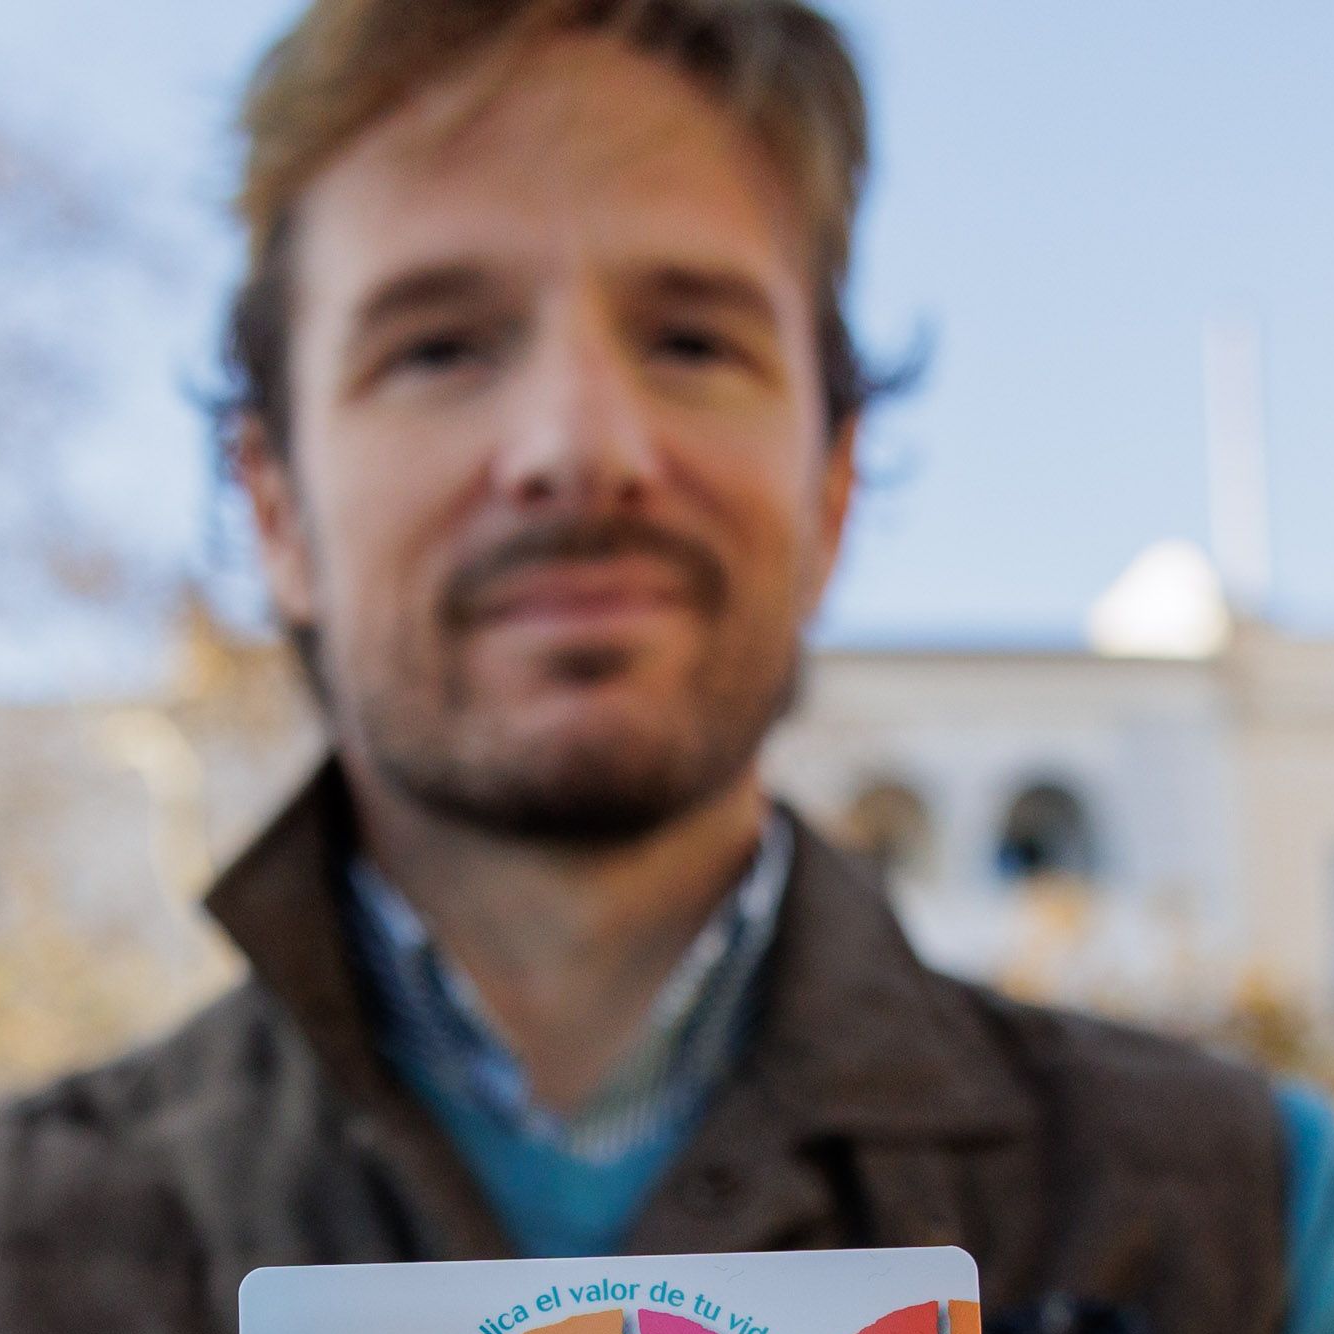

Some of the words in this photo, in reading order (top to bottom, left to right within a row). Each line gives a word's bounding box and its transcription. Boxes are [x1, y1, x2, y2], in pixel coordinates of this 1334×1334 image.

[536, 1286, 562, 1311] el
[569, 1278, 640, 1304] valor
[649, 1281, 685, 1307] de
[693, 1293, 722, 1321] tu
